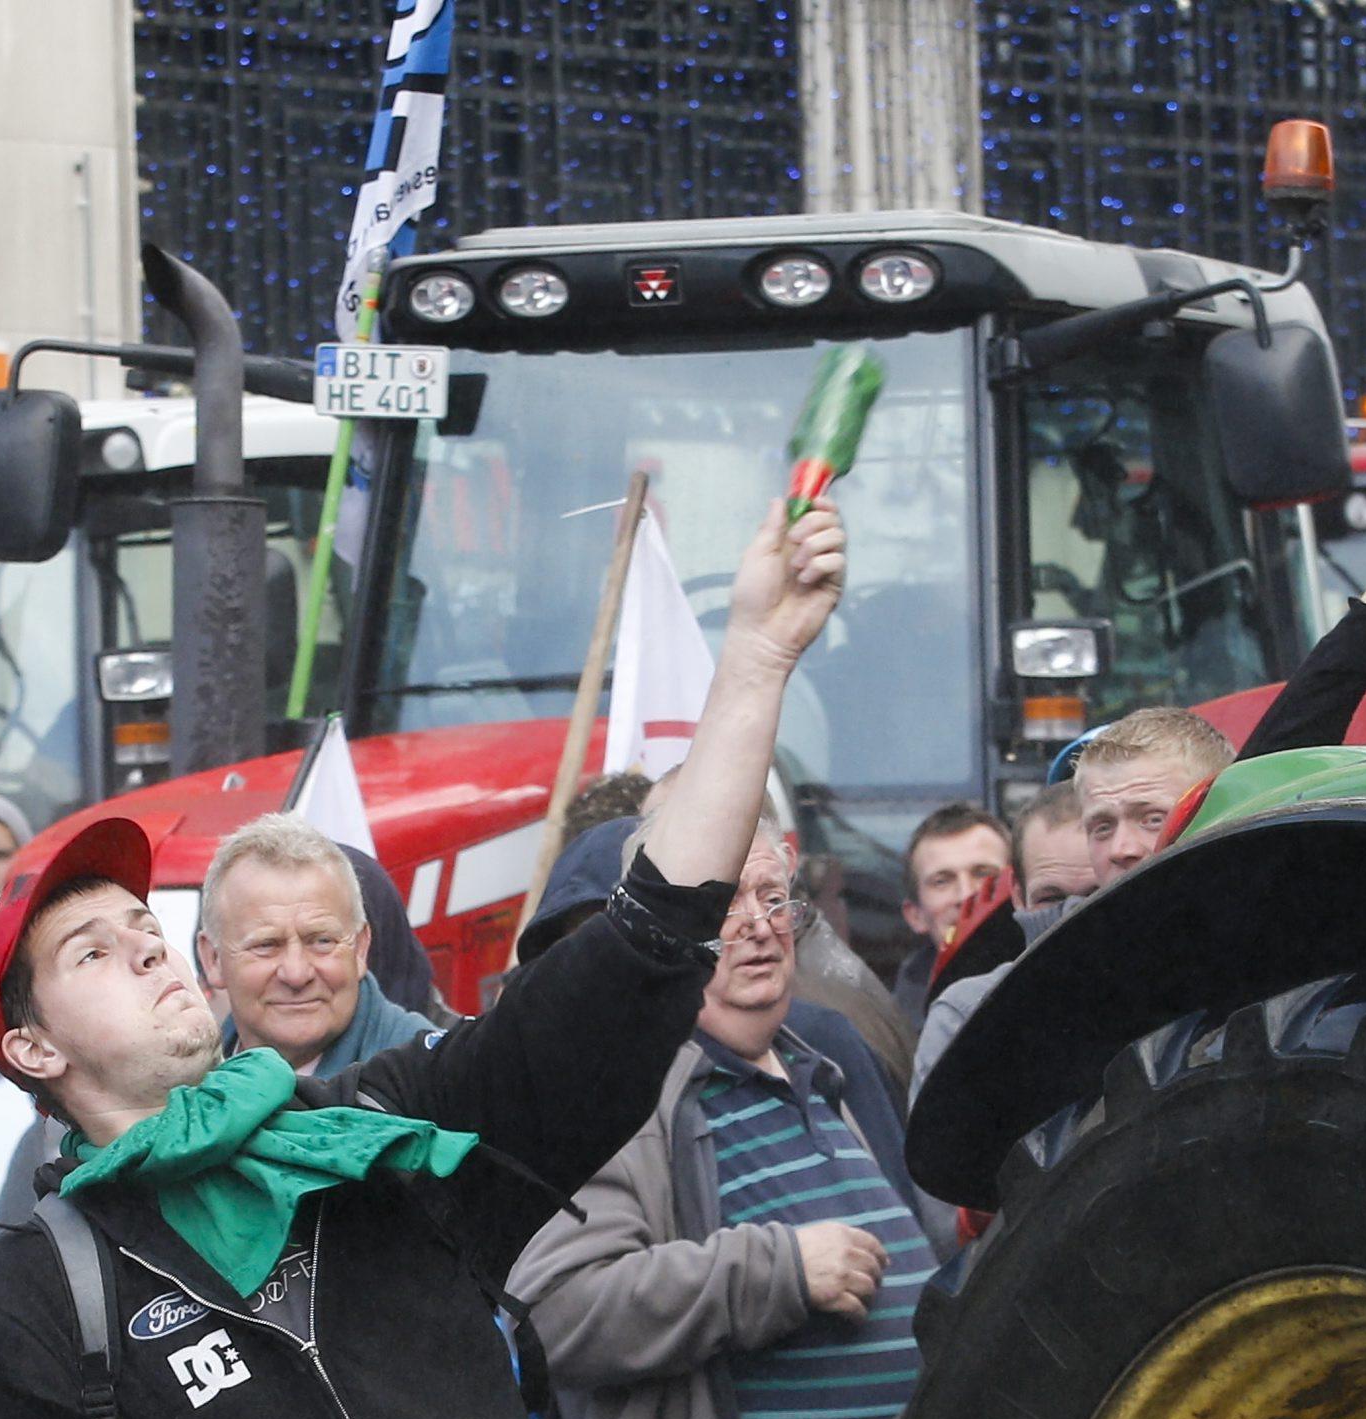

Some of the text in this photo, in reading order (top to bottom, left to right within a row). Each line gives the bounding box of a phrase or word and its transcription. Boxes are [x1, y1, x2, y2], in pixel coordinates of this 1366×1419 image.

[343, 351, 402, 380] BIT
[327, 383, 429, 413] HE 401
[167, 1328, 252, 1409] DC
